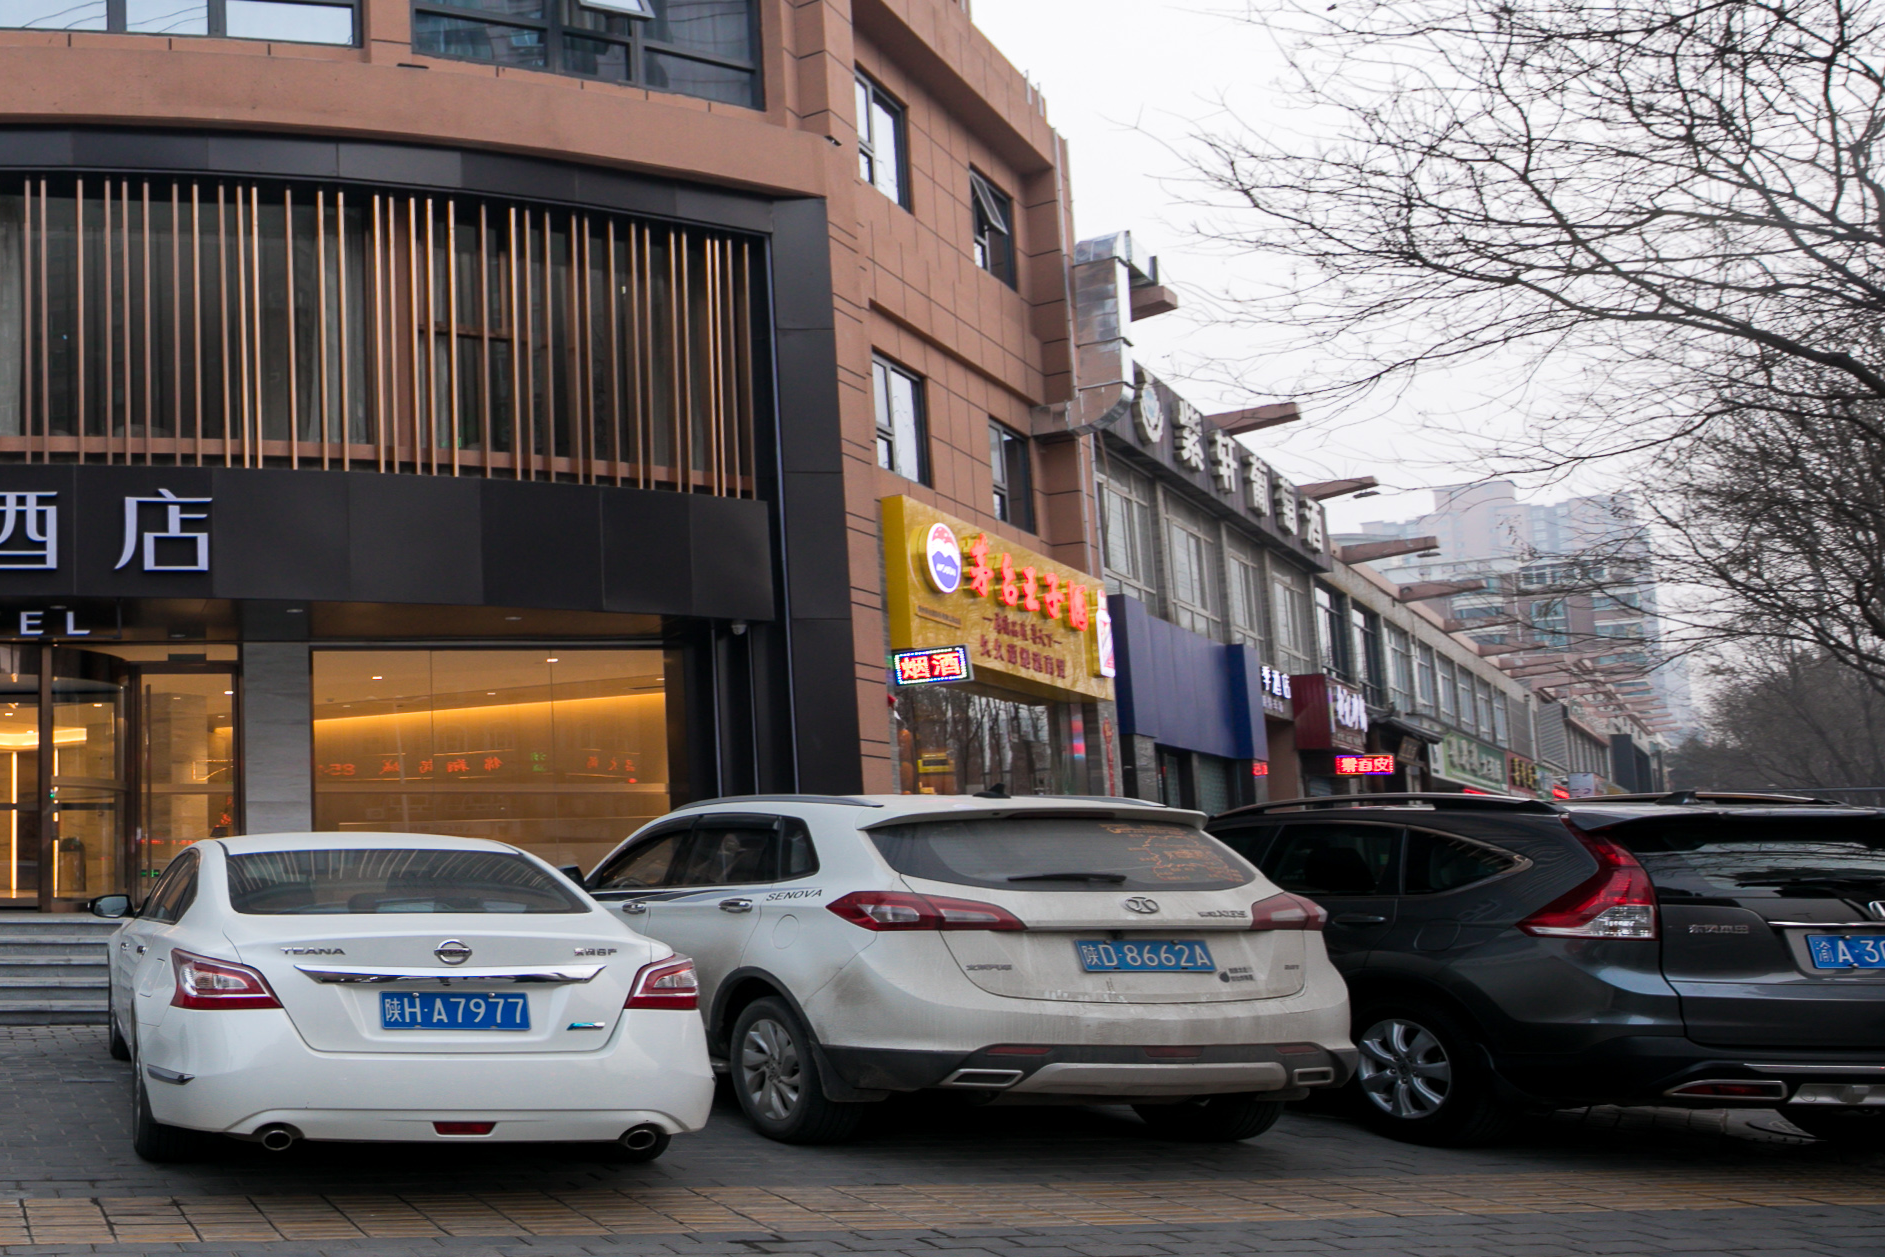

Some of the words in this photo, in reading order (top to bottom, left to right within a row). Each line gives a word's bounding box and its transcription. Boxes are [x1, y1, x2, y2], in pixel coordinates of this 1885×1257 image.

[970, 532, 1089, 632] 茅台王子酒
[900, 652, 962, 680] 烟酒
[766, 889, 822, 901] SENOVA
[280, 947, 346, 955] TEANA
